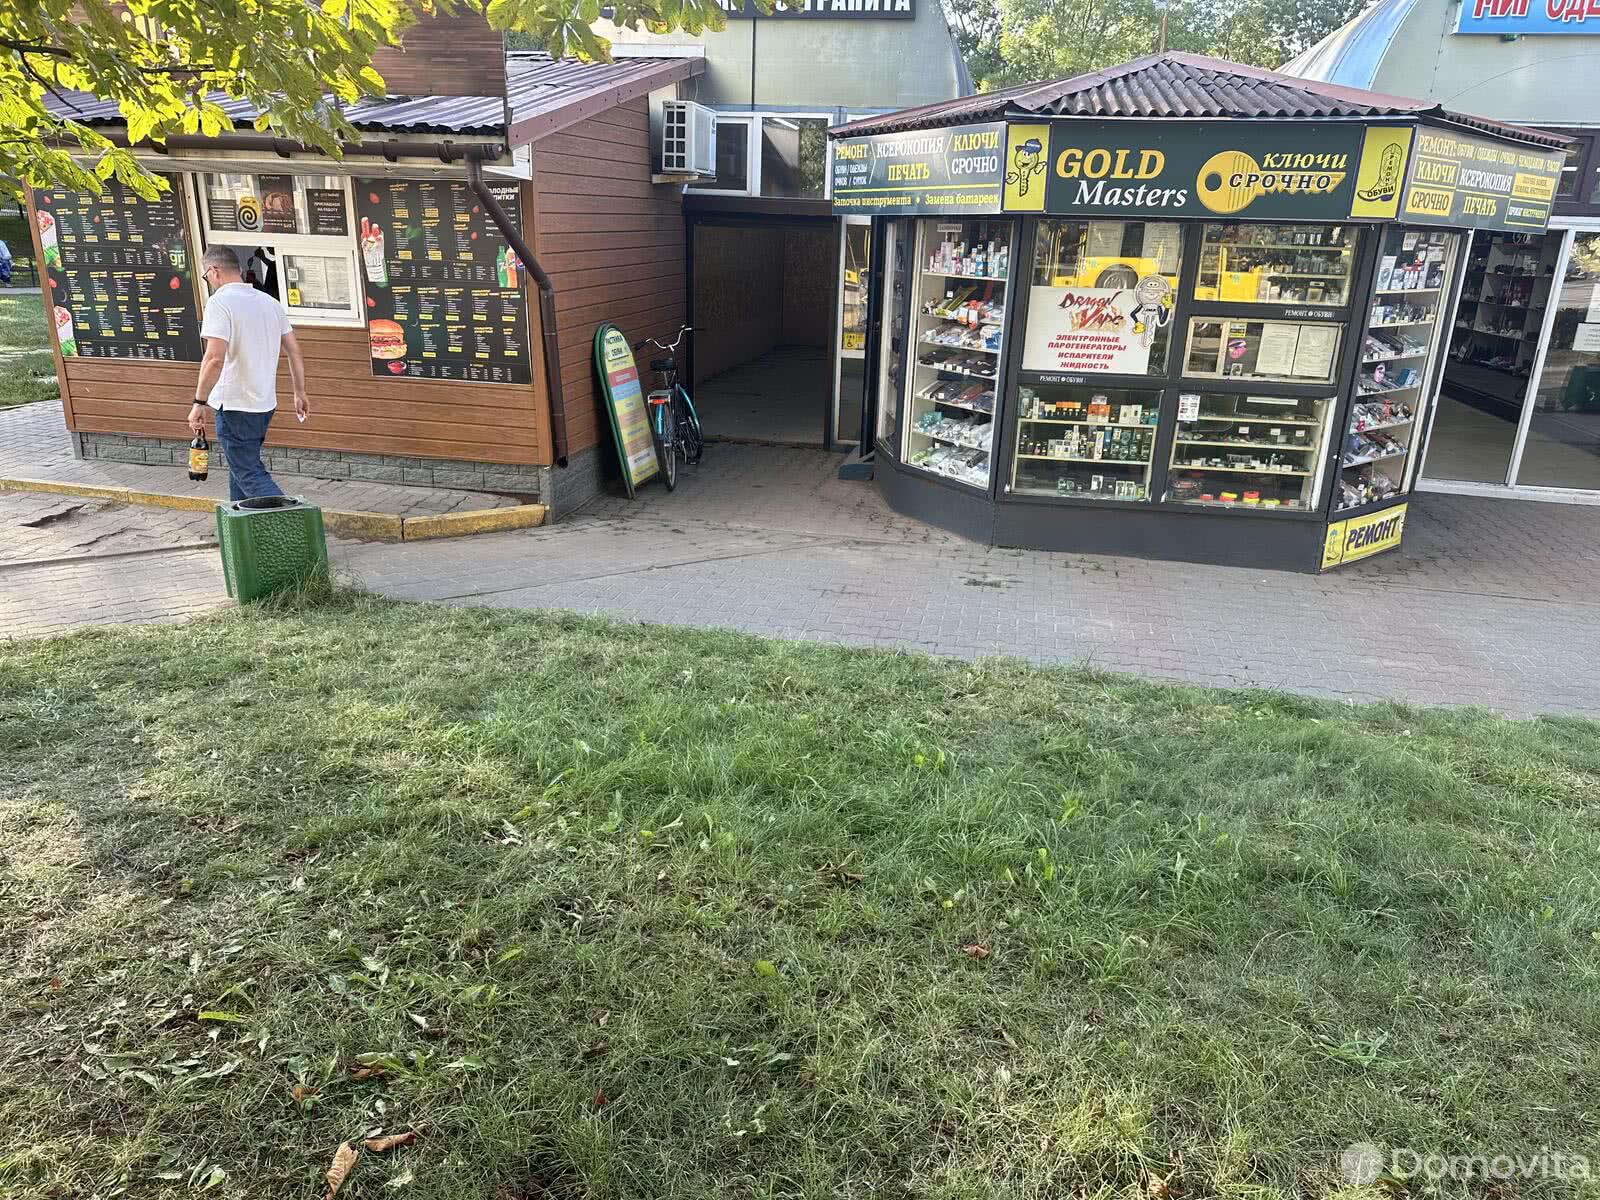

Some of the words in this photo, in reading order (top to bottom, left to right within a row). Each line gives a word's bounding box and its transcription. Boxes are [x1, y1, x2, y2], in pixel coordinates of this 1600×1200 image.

[835, 143, 869, 160] РЕМОНТ
[876, 136, 945, 158] КСЕРОКОПИЯ
[953, 131, 999, 152] КЛЮЧИ
[1417, 135, 1457, 157] РЕМОНТ:
[887, 163, 930, 181] ПЕЧАТЬ
[951, 156, 998, 175] СРОЧНО
[1055, 148, 1166, 180] GOLD
[1386, 154, 1394, 187] РЕМОНТ
[1416, 161, 1457, 183] КЛЮЧИ
[1229, 172, 1333, 191] СРОЧНО
[1459, 168, 1513, 193] КСЕРОКОПИЯ
[833, 196, 861, 206] Заточка
[862, 196, 912, 208] инструмента
[925, 193, 954, 205] Замена
[956, 192, 999, 207] батареек
[1072, 180, 1188, 208] Masters
[1367, 186, 1394, 197] ОБУВИ
[1410, 190, 1450, 211] СРОЧНО
[1462, 196, 1497, 217] ПЕЧАТЬ
[1047, 342, 1127, 351] ПАРОГЕНЕРАТОРЫ
[1055, 334, 1120, 343] ЭЛЕКТРОННЫЕ
[1057, 352, 1114, 360] ИСПАРИТЕЛИ
[1059, 362, 1110, 370] ЖИДКОСТЬ
[1346, 516, 1400, 551] РЕМОНТ
